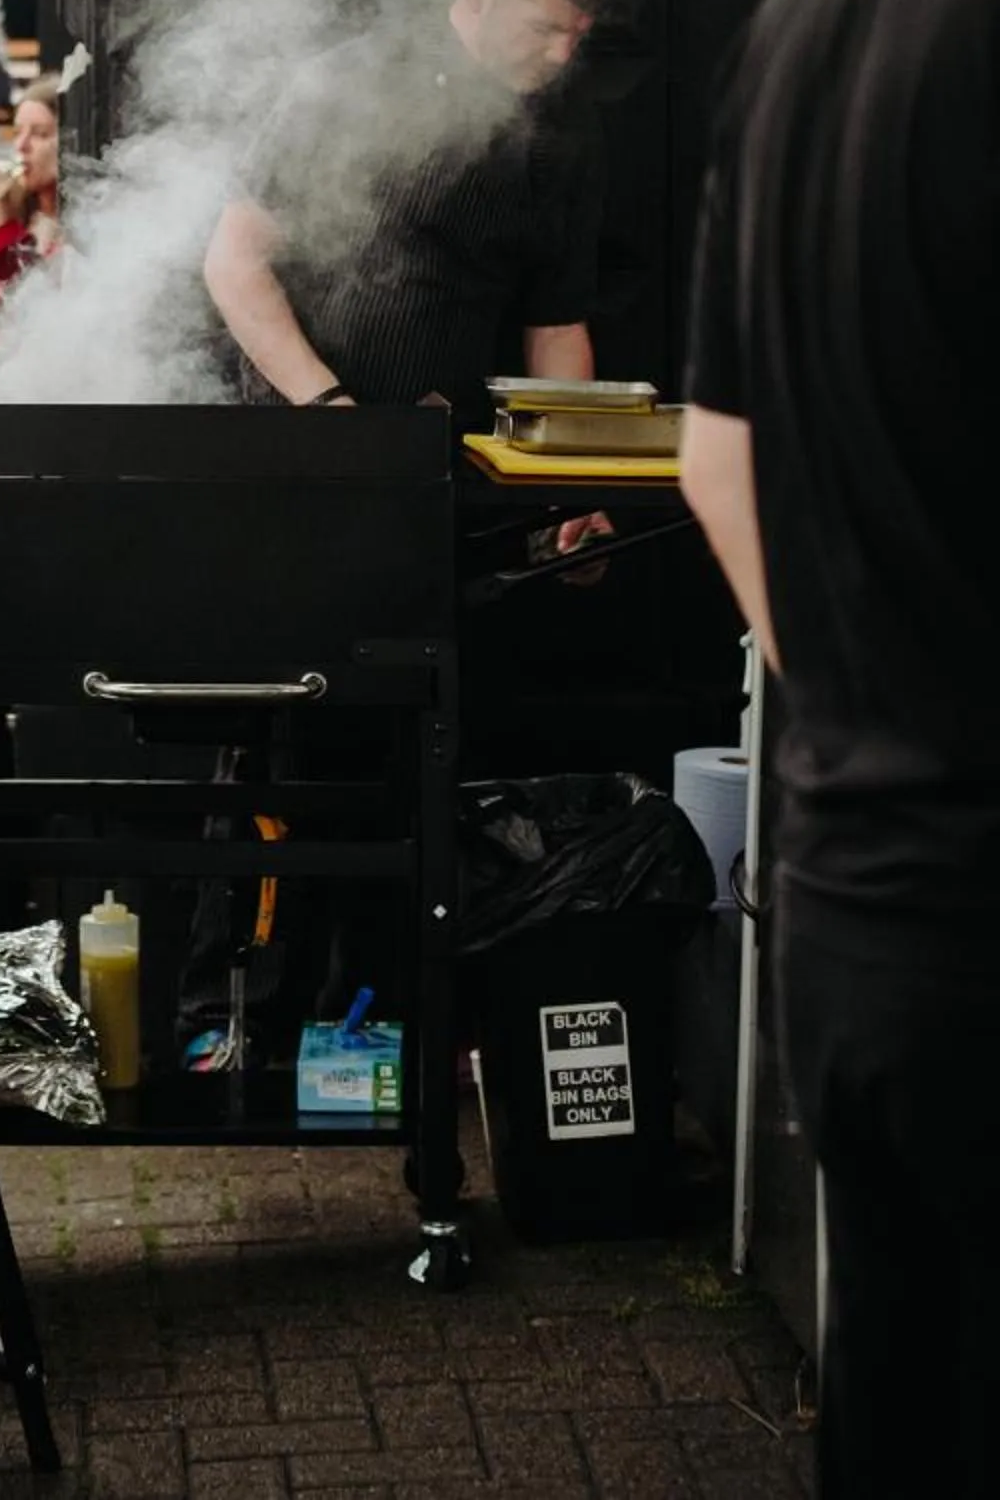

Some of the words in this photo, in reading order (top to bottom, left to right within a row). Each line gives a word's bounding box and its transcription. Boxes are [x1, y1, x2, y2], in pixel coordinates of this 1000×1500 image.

[553, 1011, 611, 1029] BLACK
[569, 1031, 598, 1047] BIN
[557, 1067, 616, 1086] BLACK
[551, 1089, 579, 1105] BIN
[583, 1084, 632, 1104] BAGS
[566, 1106, 613, 1123] ONLY
